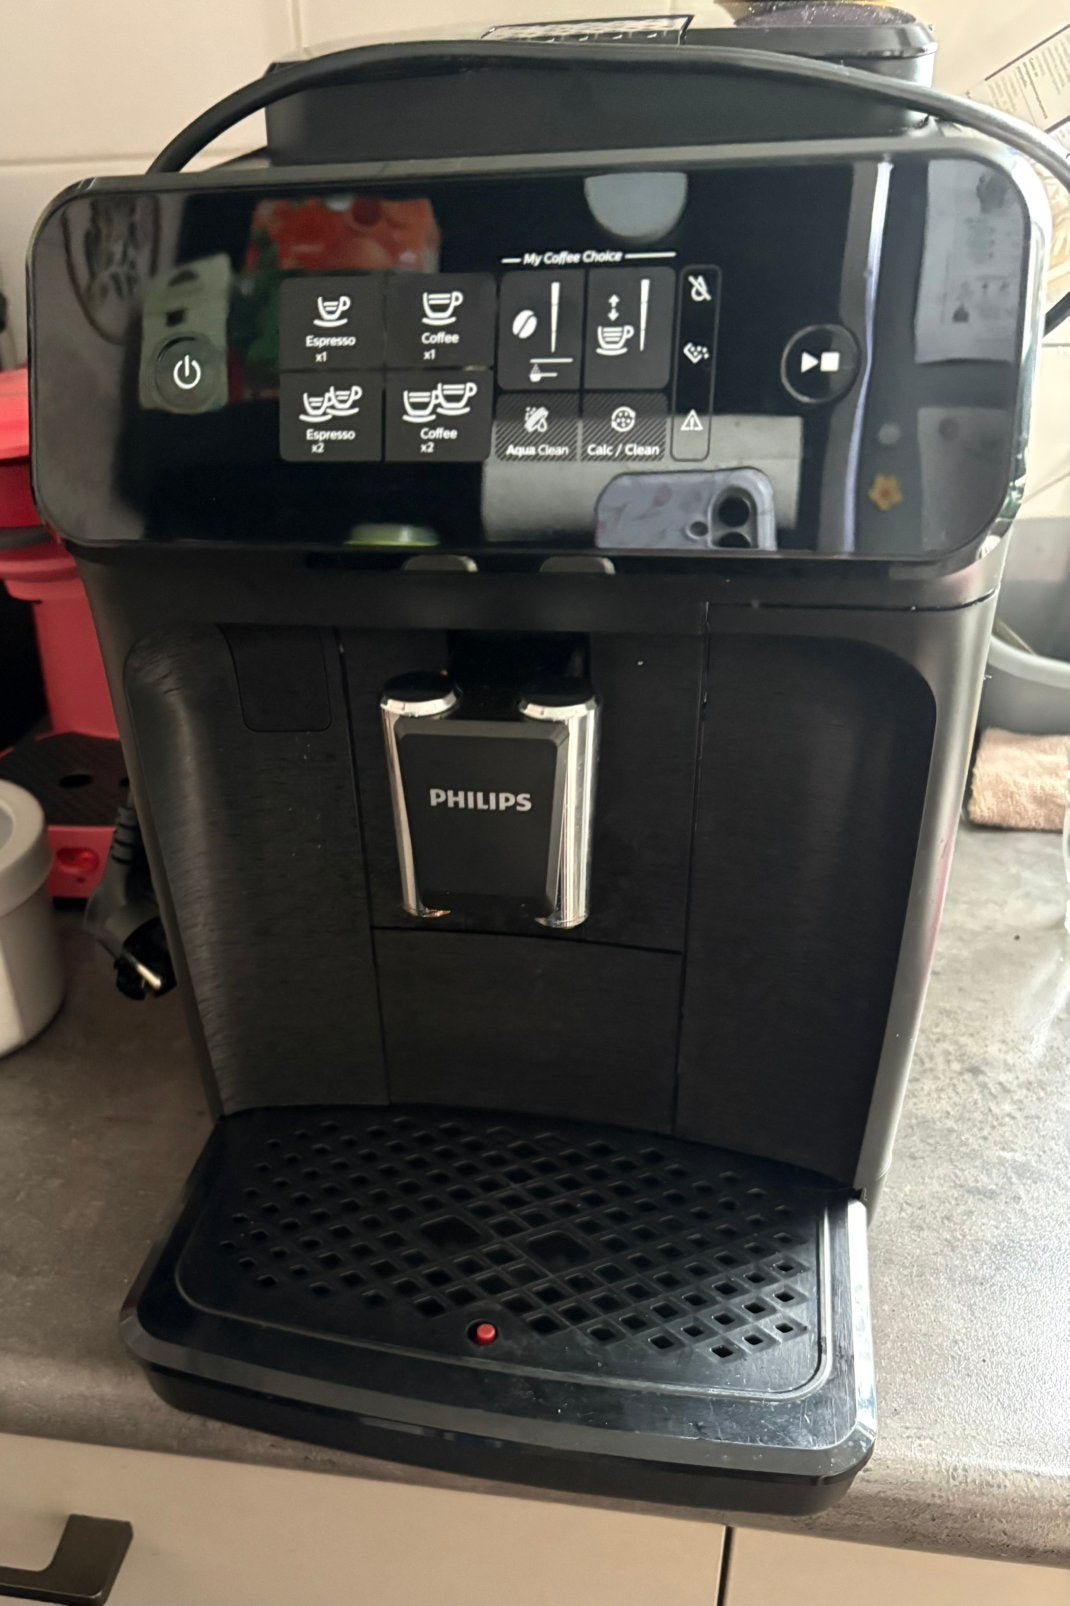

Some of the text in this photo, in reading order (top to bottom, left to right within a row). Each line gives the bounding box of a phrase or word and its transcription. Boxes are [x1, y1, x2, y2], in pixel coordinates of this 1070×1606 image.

[523, 250, 623, 266] My Coffee Choice
[305, 335, 356, 348] Espresso
[421, 331, 460, 344] Coffee
[315, 351, 327, 362] x1
[423, 349, 436, 360] x1
[306, 428, 356, 441] Espresso
[420, 427, 458, 439] Coffee
[311, 442, 325, 453] x2
[420, 442, 435, 453] x2
[506, 444, 569, 457] Aqua Clean
[587, 444, 613, 456] Calc
[625, 443, 660, 456] Clean
[429, 788, 532, 812] PHILIPS
